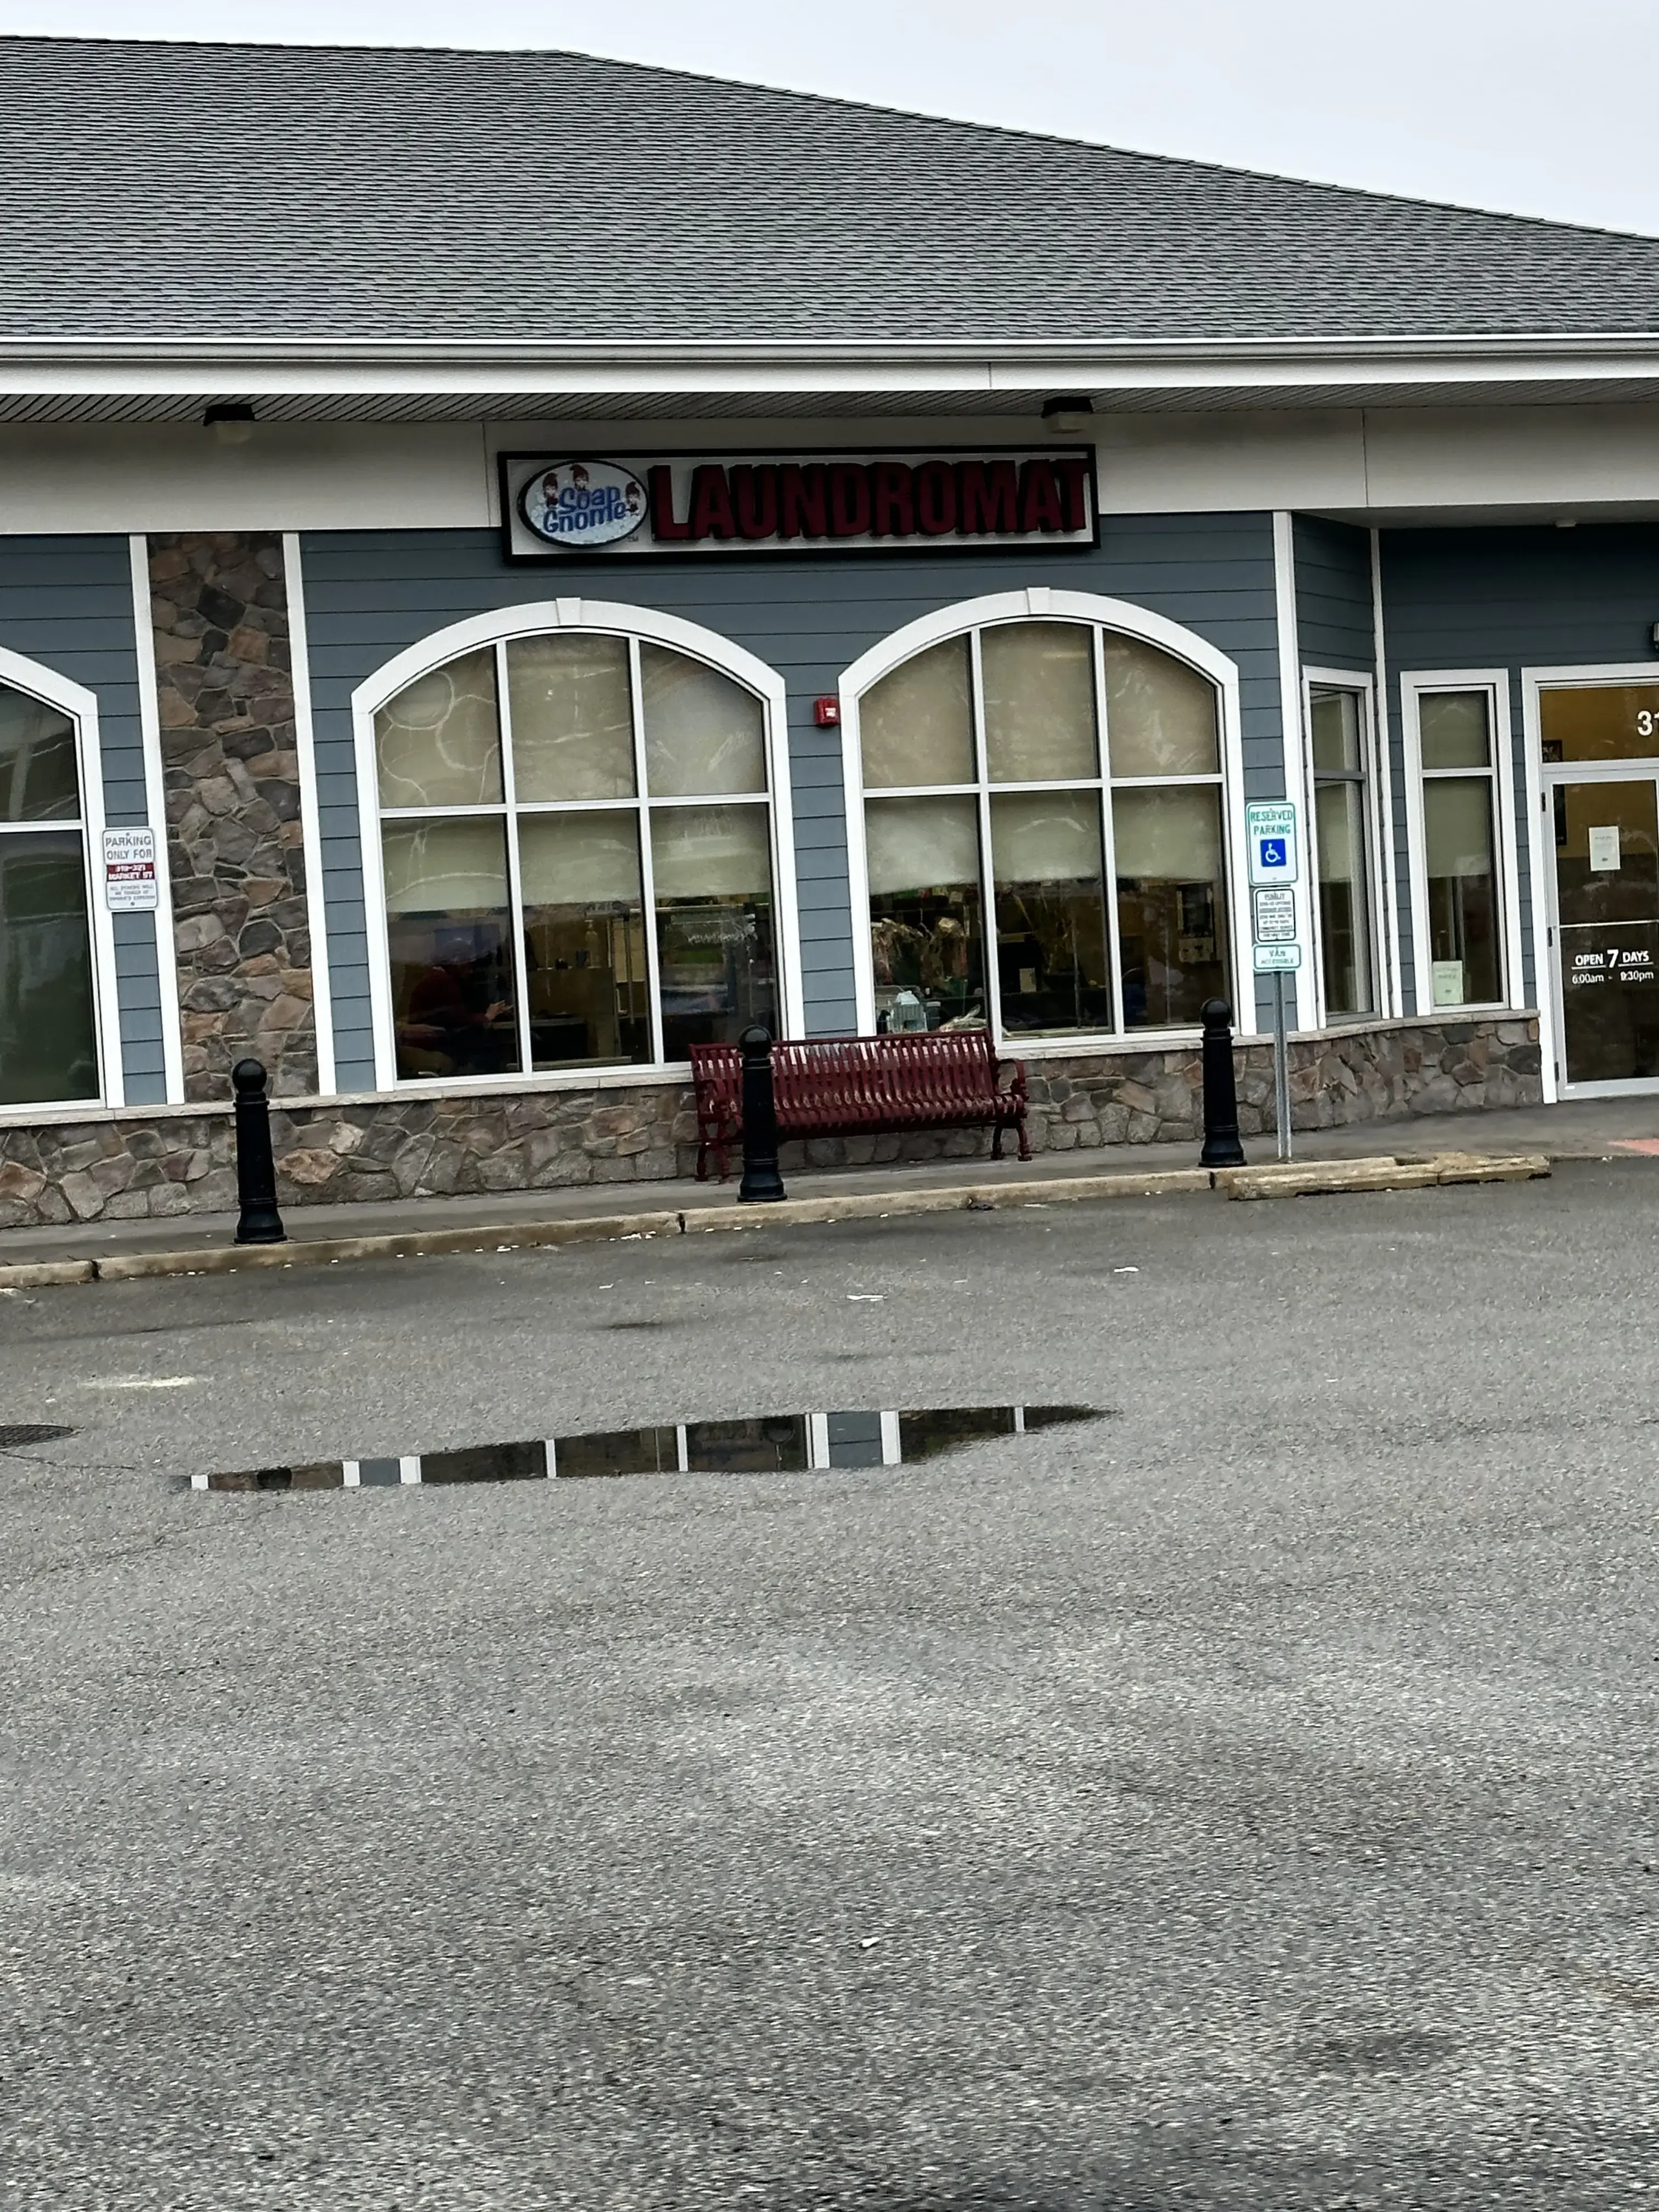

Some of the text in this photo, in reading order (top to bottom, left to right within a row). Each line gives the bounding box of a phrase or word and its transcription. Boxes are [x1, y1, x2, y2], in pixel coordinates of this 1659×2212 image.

[558, 486, 622, 514] Soap
[649, 459, 1090, 541] LAUNDROMAT
[543, 501, 627, 533] Gnome
[1250, 810, 1293, 823] RESERVED
[1254, 824, 1291, 835] PARKING
[105, 836, 151, 847] PARKING
[106, 849, 152, 860] ONLY FOR
[1575, 949, 1649, 968] OPEN 7 DAYS
